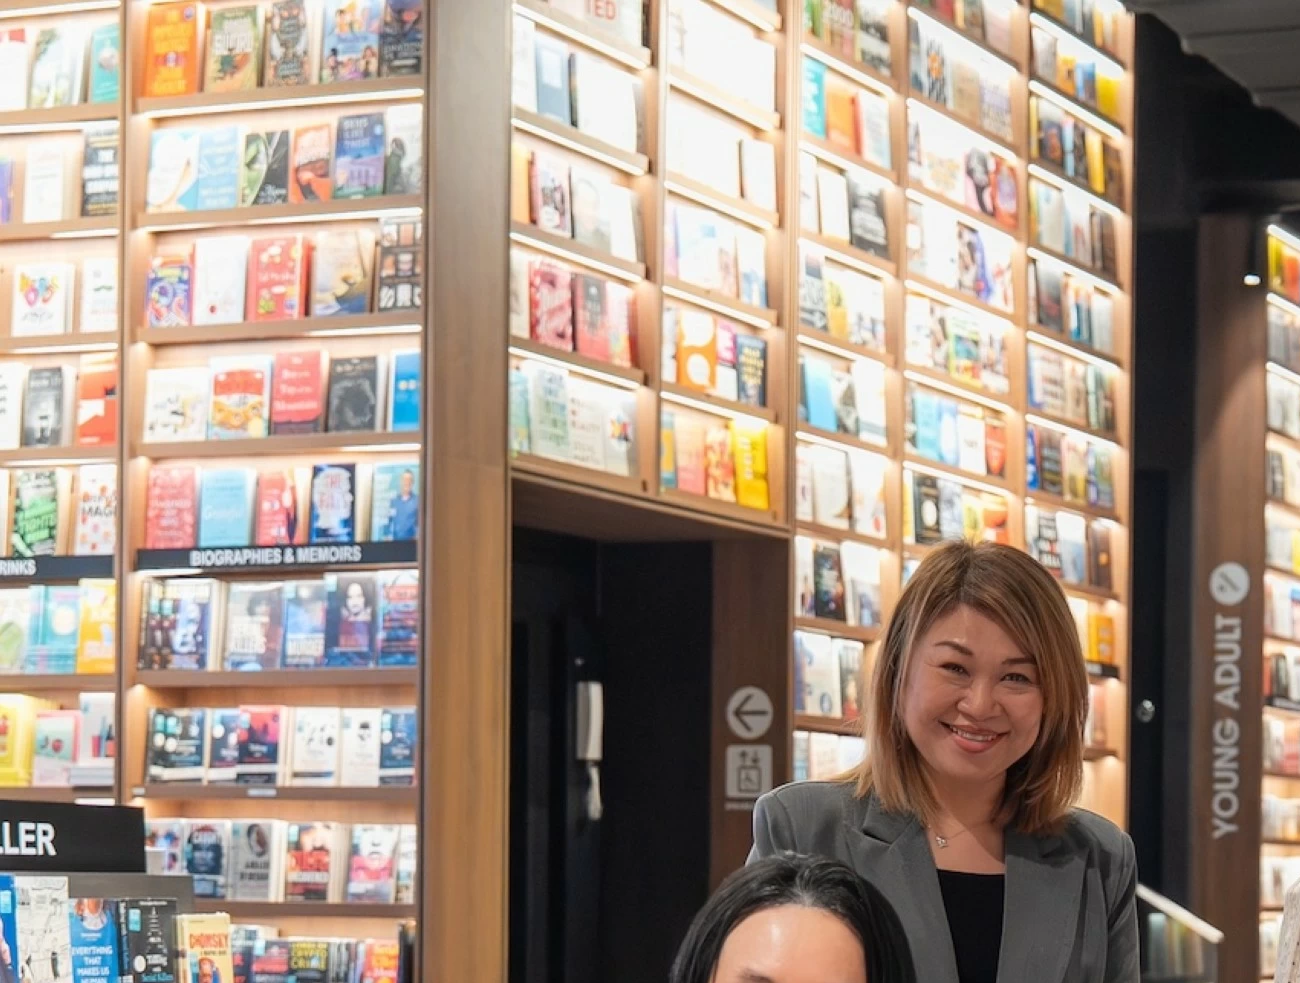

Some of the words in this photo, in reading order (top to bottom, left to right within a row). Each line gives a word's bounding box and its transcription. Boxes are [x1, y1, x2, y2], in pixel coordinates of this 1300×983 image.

[190, 548, 281, 567] BIOGRAPHIES
[284, 547, 293, 563] &
[296, 545, 361, 564] MEMOIRS
[0, 558, 36, 576] RINKS
[1214, 615, 1241, 709] ADULT
[1211, 722, 1240, 840] YOUNG
[0, 821, 56, 856] LER
[189, 933, 228, 948] CHOMSKY
[71, 945, 113, 955] EVERYTHING
[83, 957, 102, 965] THAT
[77, 967, 98, 976] MAKES
[99, 966, 110, 975] US
